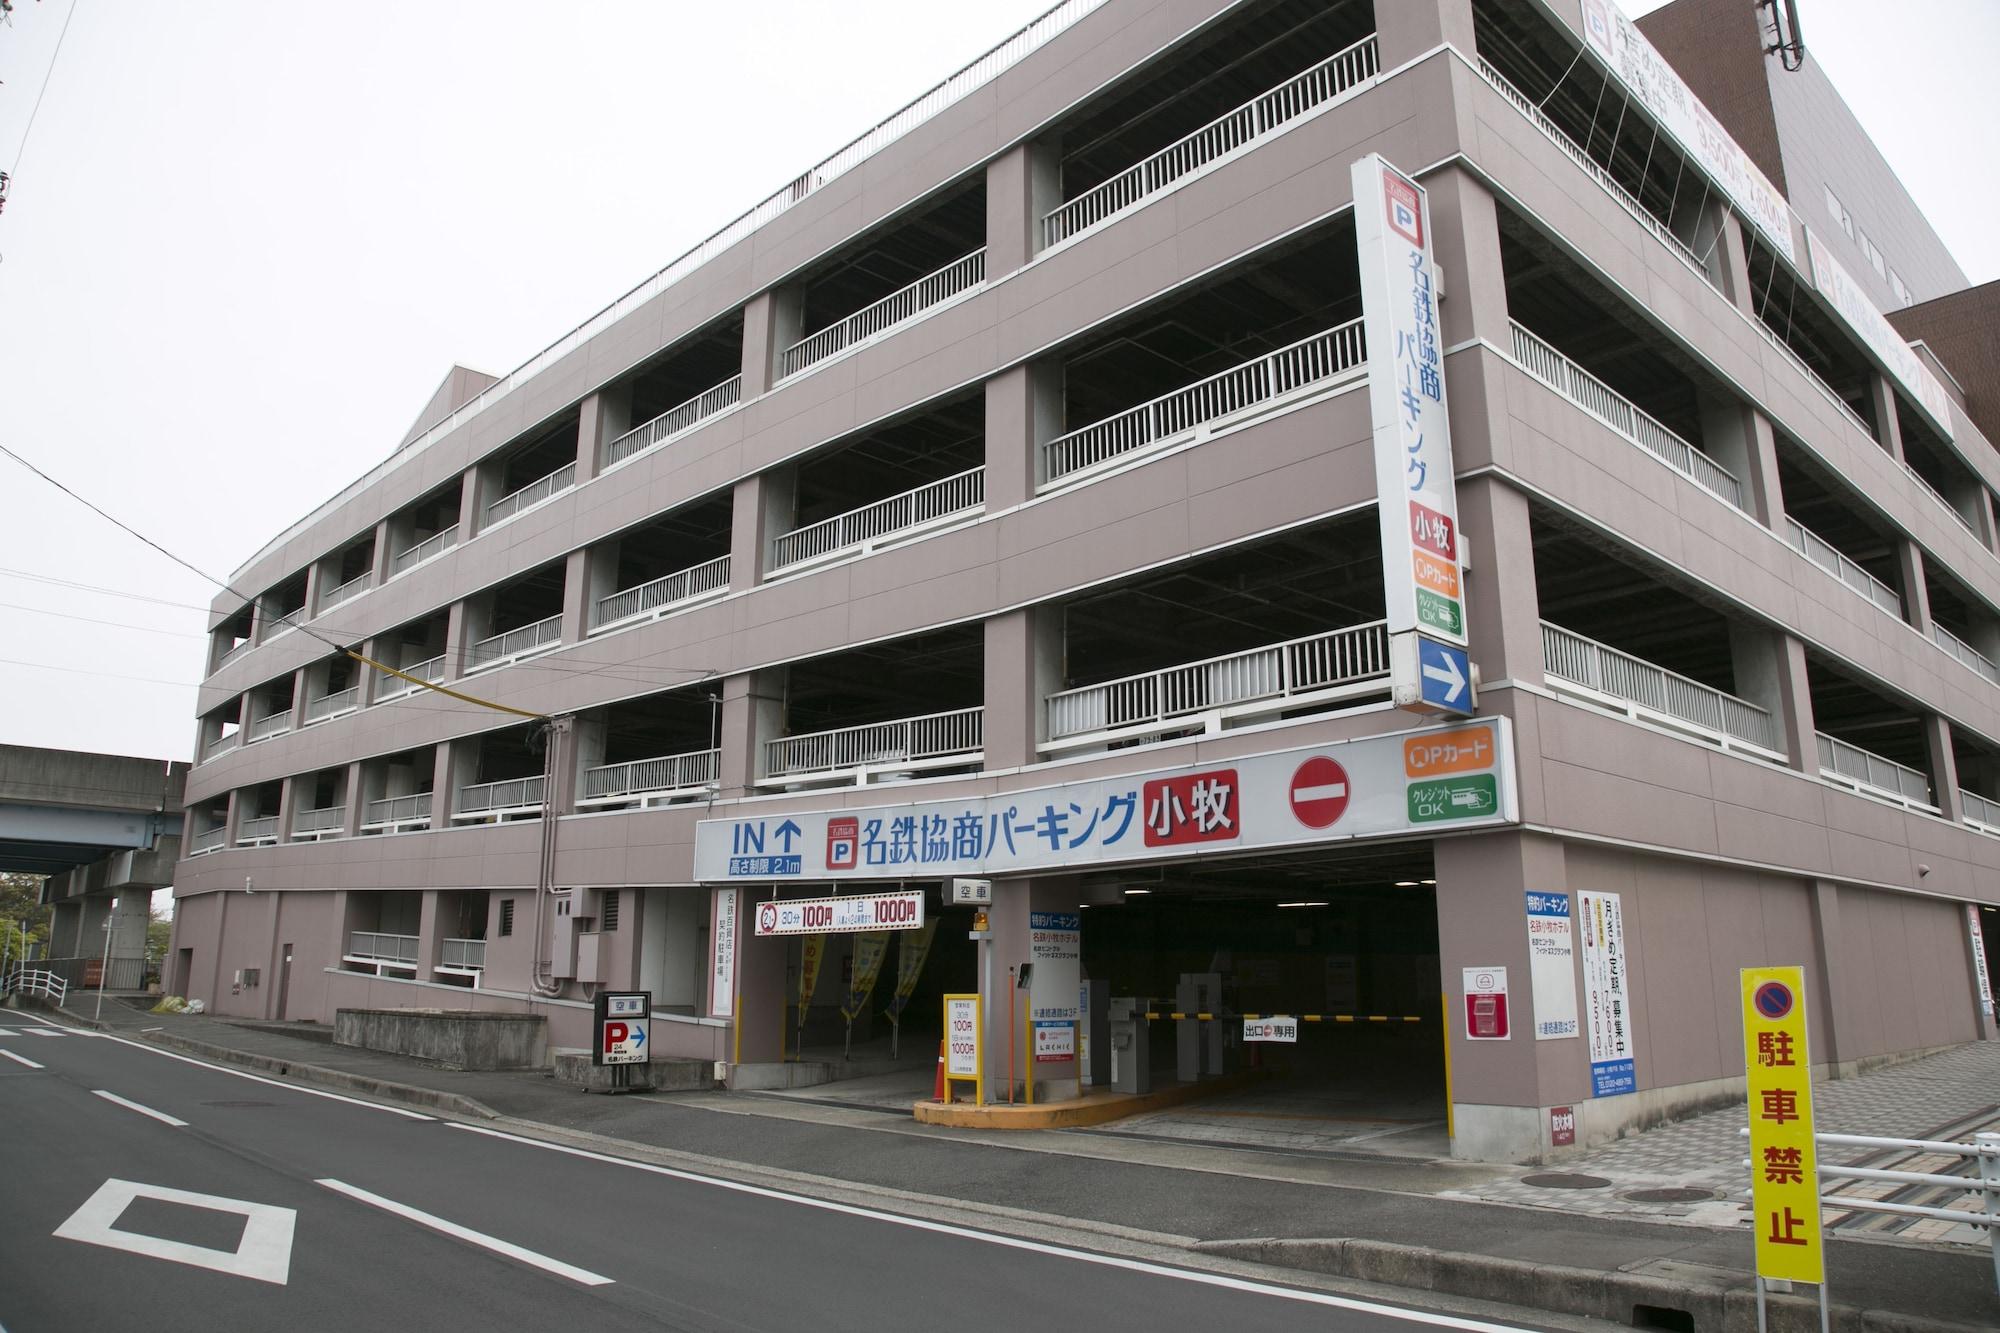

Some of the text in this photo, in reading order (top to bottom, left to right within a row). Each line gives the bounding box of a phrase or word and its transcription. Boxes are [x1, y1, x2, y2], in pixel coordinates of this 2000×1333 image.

[1396, 204, 1412, 226] P
[1409, 250, 1441, 402] 名鉄協商
[1398, 330, 1427, 492] パーキング
[1415, 510, 1450, 552] 小牧
[1422, 607, 1437, 623] OK
[1413, 785, 1451, 803] クレジット
[1147, 778, 1232, 837] 小牧
[1418, 803, 1445, 816] OK
[733, 821, 765, 854] IN
[861, 791, 1137, 865] 名鉄協商パーキング
[835, 843, 849, 860] P
[730, 857, 800, 875] 高さ制限 2.1m
[960, 885, 986, 899] 空車
[874, 899, 916, 924] 1000円
[1527, 894, 1570, 913] 特約パーキング
[726, 893, 734, 950] 名鉄百貨店
[781, 905, 833, 928] 30分 100円
[1031, 913, 1079, 928] 特約パーキング
[1529, 918, 1570, 934] 名鉄小牧ホテル
[1033, 932, 1078, 944] 名鉄小牧ホテル
[717, 919, 726, 977] 契約駐車場
[615, 1000, 637, 1011] 空車
[953, 1020, 973, 1032] 100円
[1245, 1024, 1295, 1038] 出口 専用
[1612, 1000, 1625, 1057] 募集中
[605, 1022, 629, 1053] P
[952, 1043, 975, 1055] 1000円
[608, 1055, 643, 1063] 名鉄パーキング
[1757, 1031, 1808, 1246] 駐車禁止
